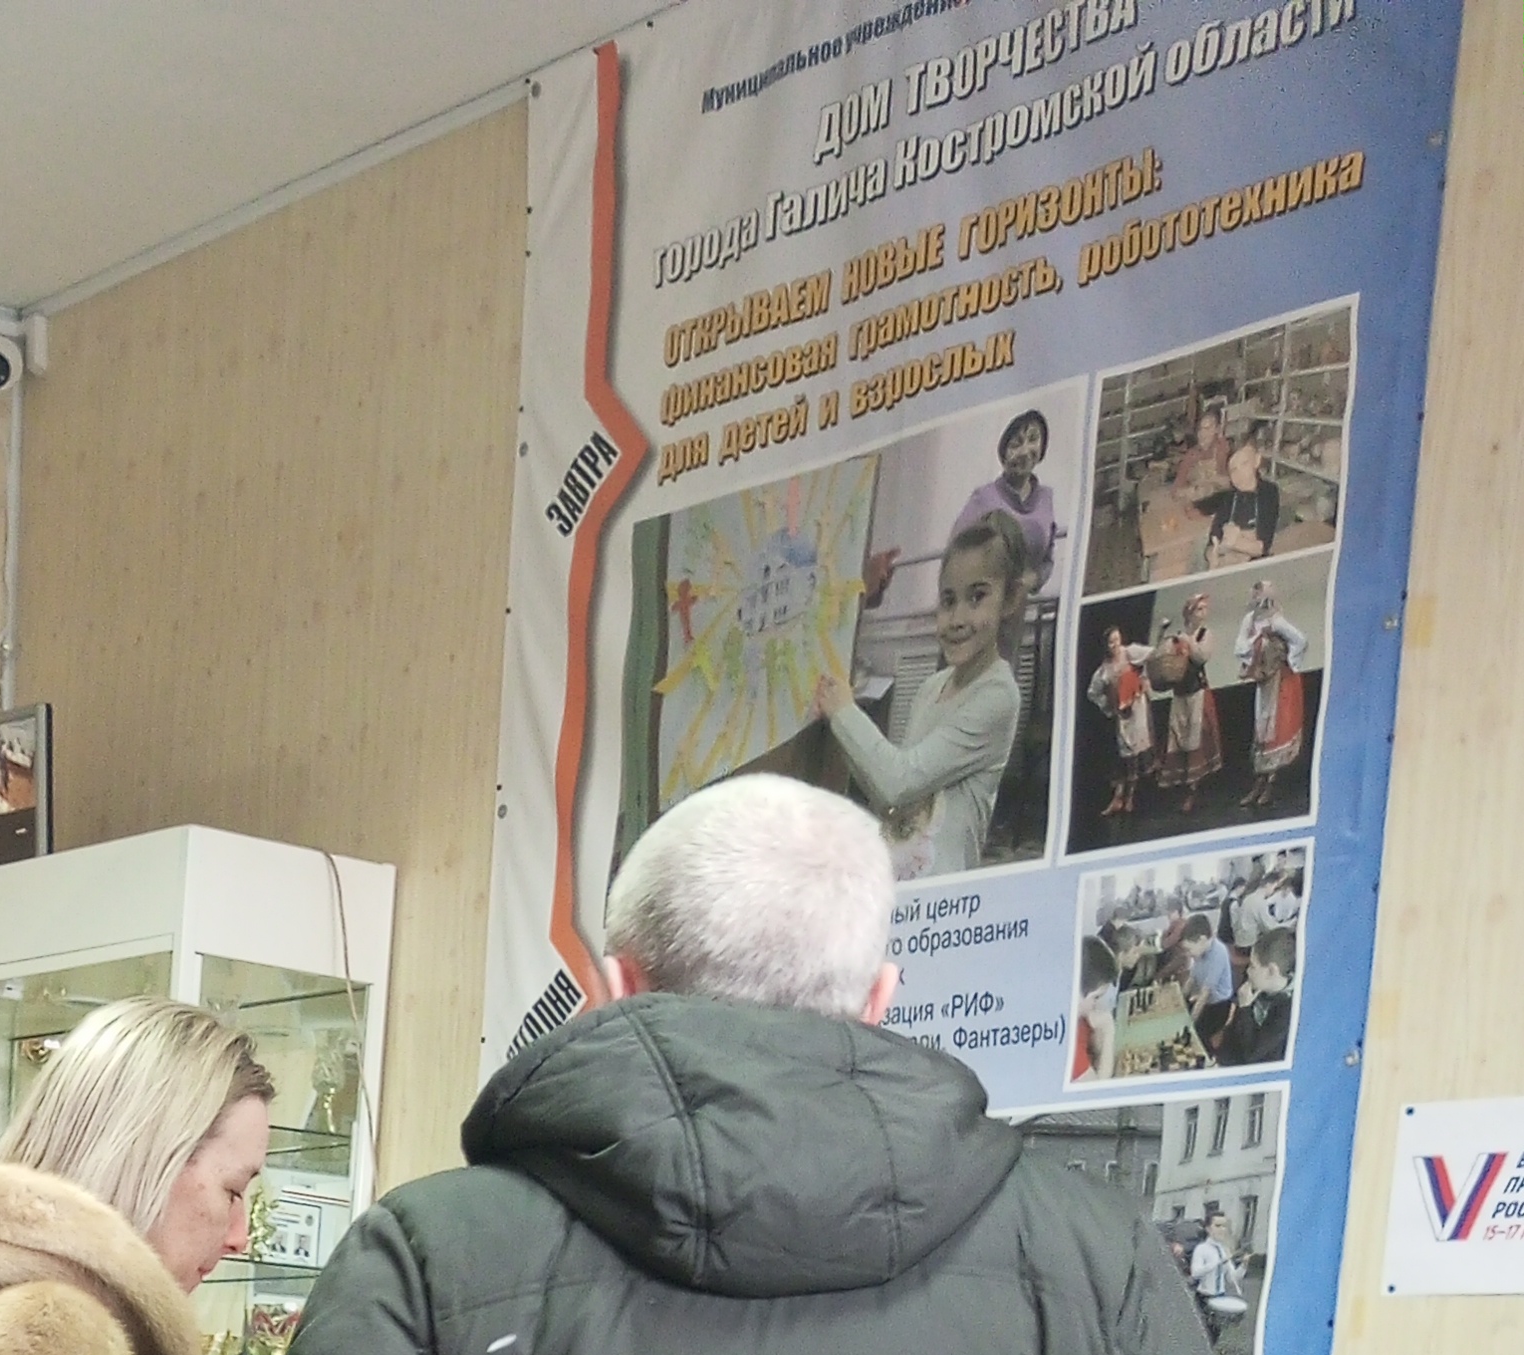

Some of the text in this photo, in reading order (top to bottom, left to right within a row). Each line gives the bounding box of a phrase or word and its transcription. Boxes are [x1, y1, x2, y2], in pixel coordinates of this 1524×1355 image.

[843, 0, 963, 54] учреждени
[814, 0, 1139, 163] ДОМ ТВОРЧЕСТВА
[654, 0, 1358, 288] города Галича Костромской области
[660, 149, 1366, 428] финансовая грамотность, робототехника
[664, 146, 1163, 368] ОТКРЫВАЕМ НОВЫЕ ГОРИЗОНТЫ:
[657, 328, 1016, 486] для детей и взрослых
[545, 430, 619, 538] ЗАВТРА
[907, 918, 1029, 957] образования
[925, 893, 981, 925] центр
[940, 991, 1005, 1020] «РИФ»
[952, 1013, 1066, 1050] Фантазеры)
